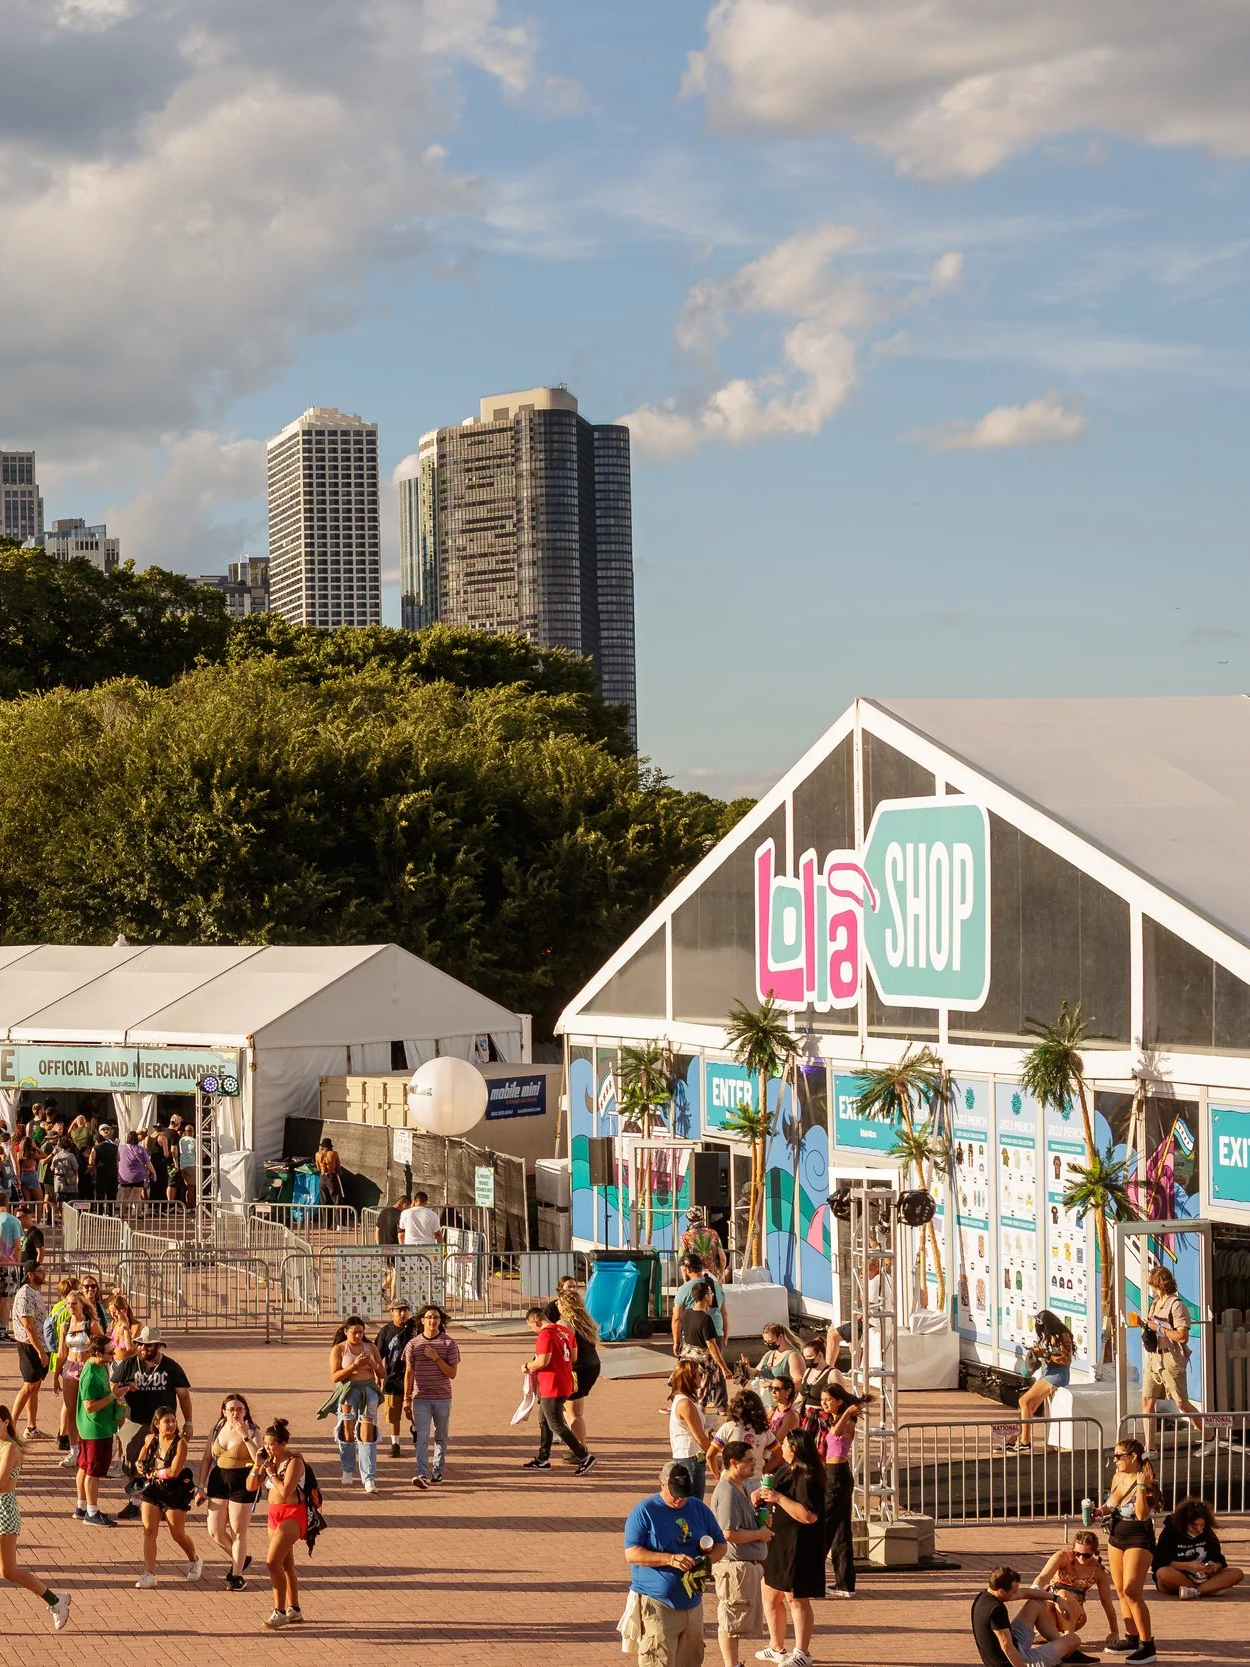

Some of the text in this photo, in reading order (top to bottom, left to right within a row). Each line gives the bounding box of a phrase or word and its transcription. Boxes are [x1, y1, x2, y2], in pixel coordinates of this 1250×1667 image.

[885, 841, 974, 972] SHOP
[39, 1059, 226, 1080] OFFICIAL BAND MERCHANDISE
[490, 1081, 542, 1100] mobile mini
[712, 1076, 753, 1111] ENTER
[1219, 1135, 1250, 1168] EXI
